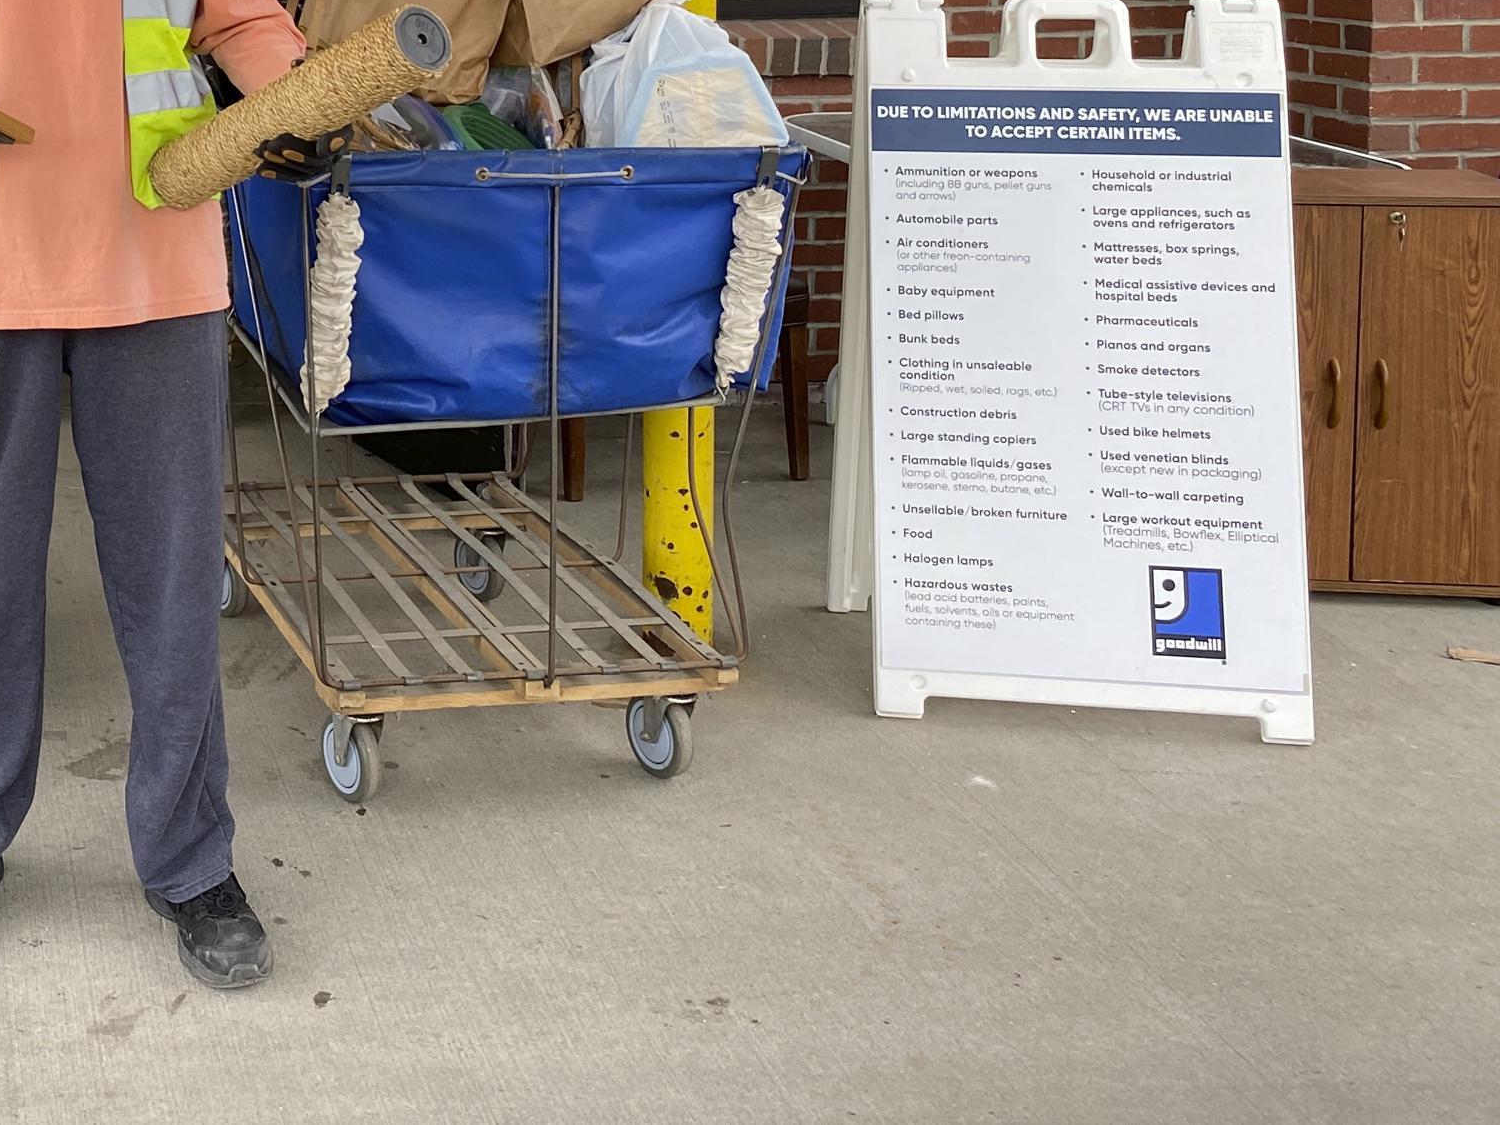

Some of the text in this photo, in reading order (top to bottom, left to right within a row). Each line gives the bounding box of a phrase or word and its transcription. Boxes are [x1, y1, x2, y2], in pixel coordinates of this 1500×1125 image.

[877, 105, 1274, 124] DUE TO LIMITATIONS AND SAFETY, WE ARE UNABLE
[965, 124, 1182, 141] TO ACCEPT CERTAIN ITEMS.
[895, 165, 1038, 180] Ammunition or weapons
[1092, 168, 1232, 182] Household or industrial
[1092, 181, 1153, 192] chemicals
[1093, 205, 1251, 219] Large appliances, such as
[896, 213, 998, 227] Automobile parts
[1093, 218, 1235, 232] ovens and refrigerators
[896, 237, 989, 250] Air conditioners
[1094, 241, 1240, 258] Mattresses, box springs,
[1094, 254, 1163, 266] water beds
[898, 284, 995, 299] Baby equipment
[898, 308, 965, 322] Bed pillows
[1096, 314, 1199, 328] Pharmaceuticals
[899, 332, 960, 345] Bunk beds
[1097, 338, 1211, 355] Pianos and organs
[899, 357, 1032, 372] Clothing in unsaleable
[1098, 363, 1201, 378] Smoke detectors
[899, 370, 955, 381] condition
[1098, 387, 1232, 404] Tube-style televisions
[900, 406, 1017, 420] Construction debris
[1099, 424, 1211, 440] Used bike helmets
[902, 455, 968, 467] Flammable
[1100, 450, 1229, 466] Used venetian blinds
[1101, 486, 1244, 506] Wall-to-wall carpeting
[903, 527, 933, 539] Food
[904, 552, 994, 569] Halogen lamps
[905, 576, 1013, 593] Hazardous wastes
[1156, 638, 1222, 652] goodwill
